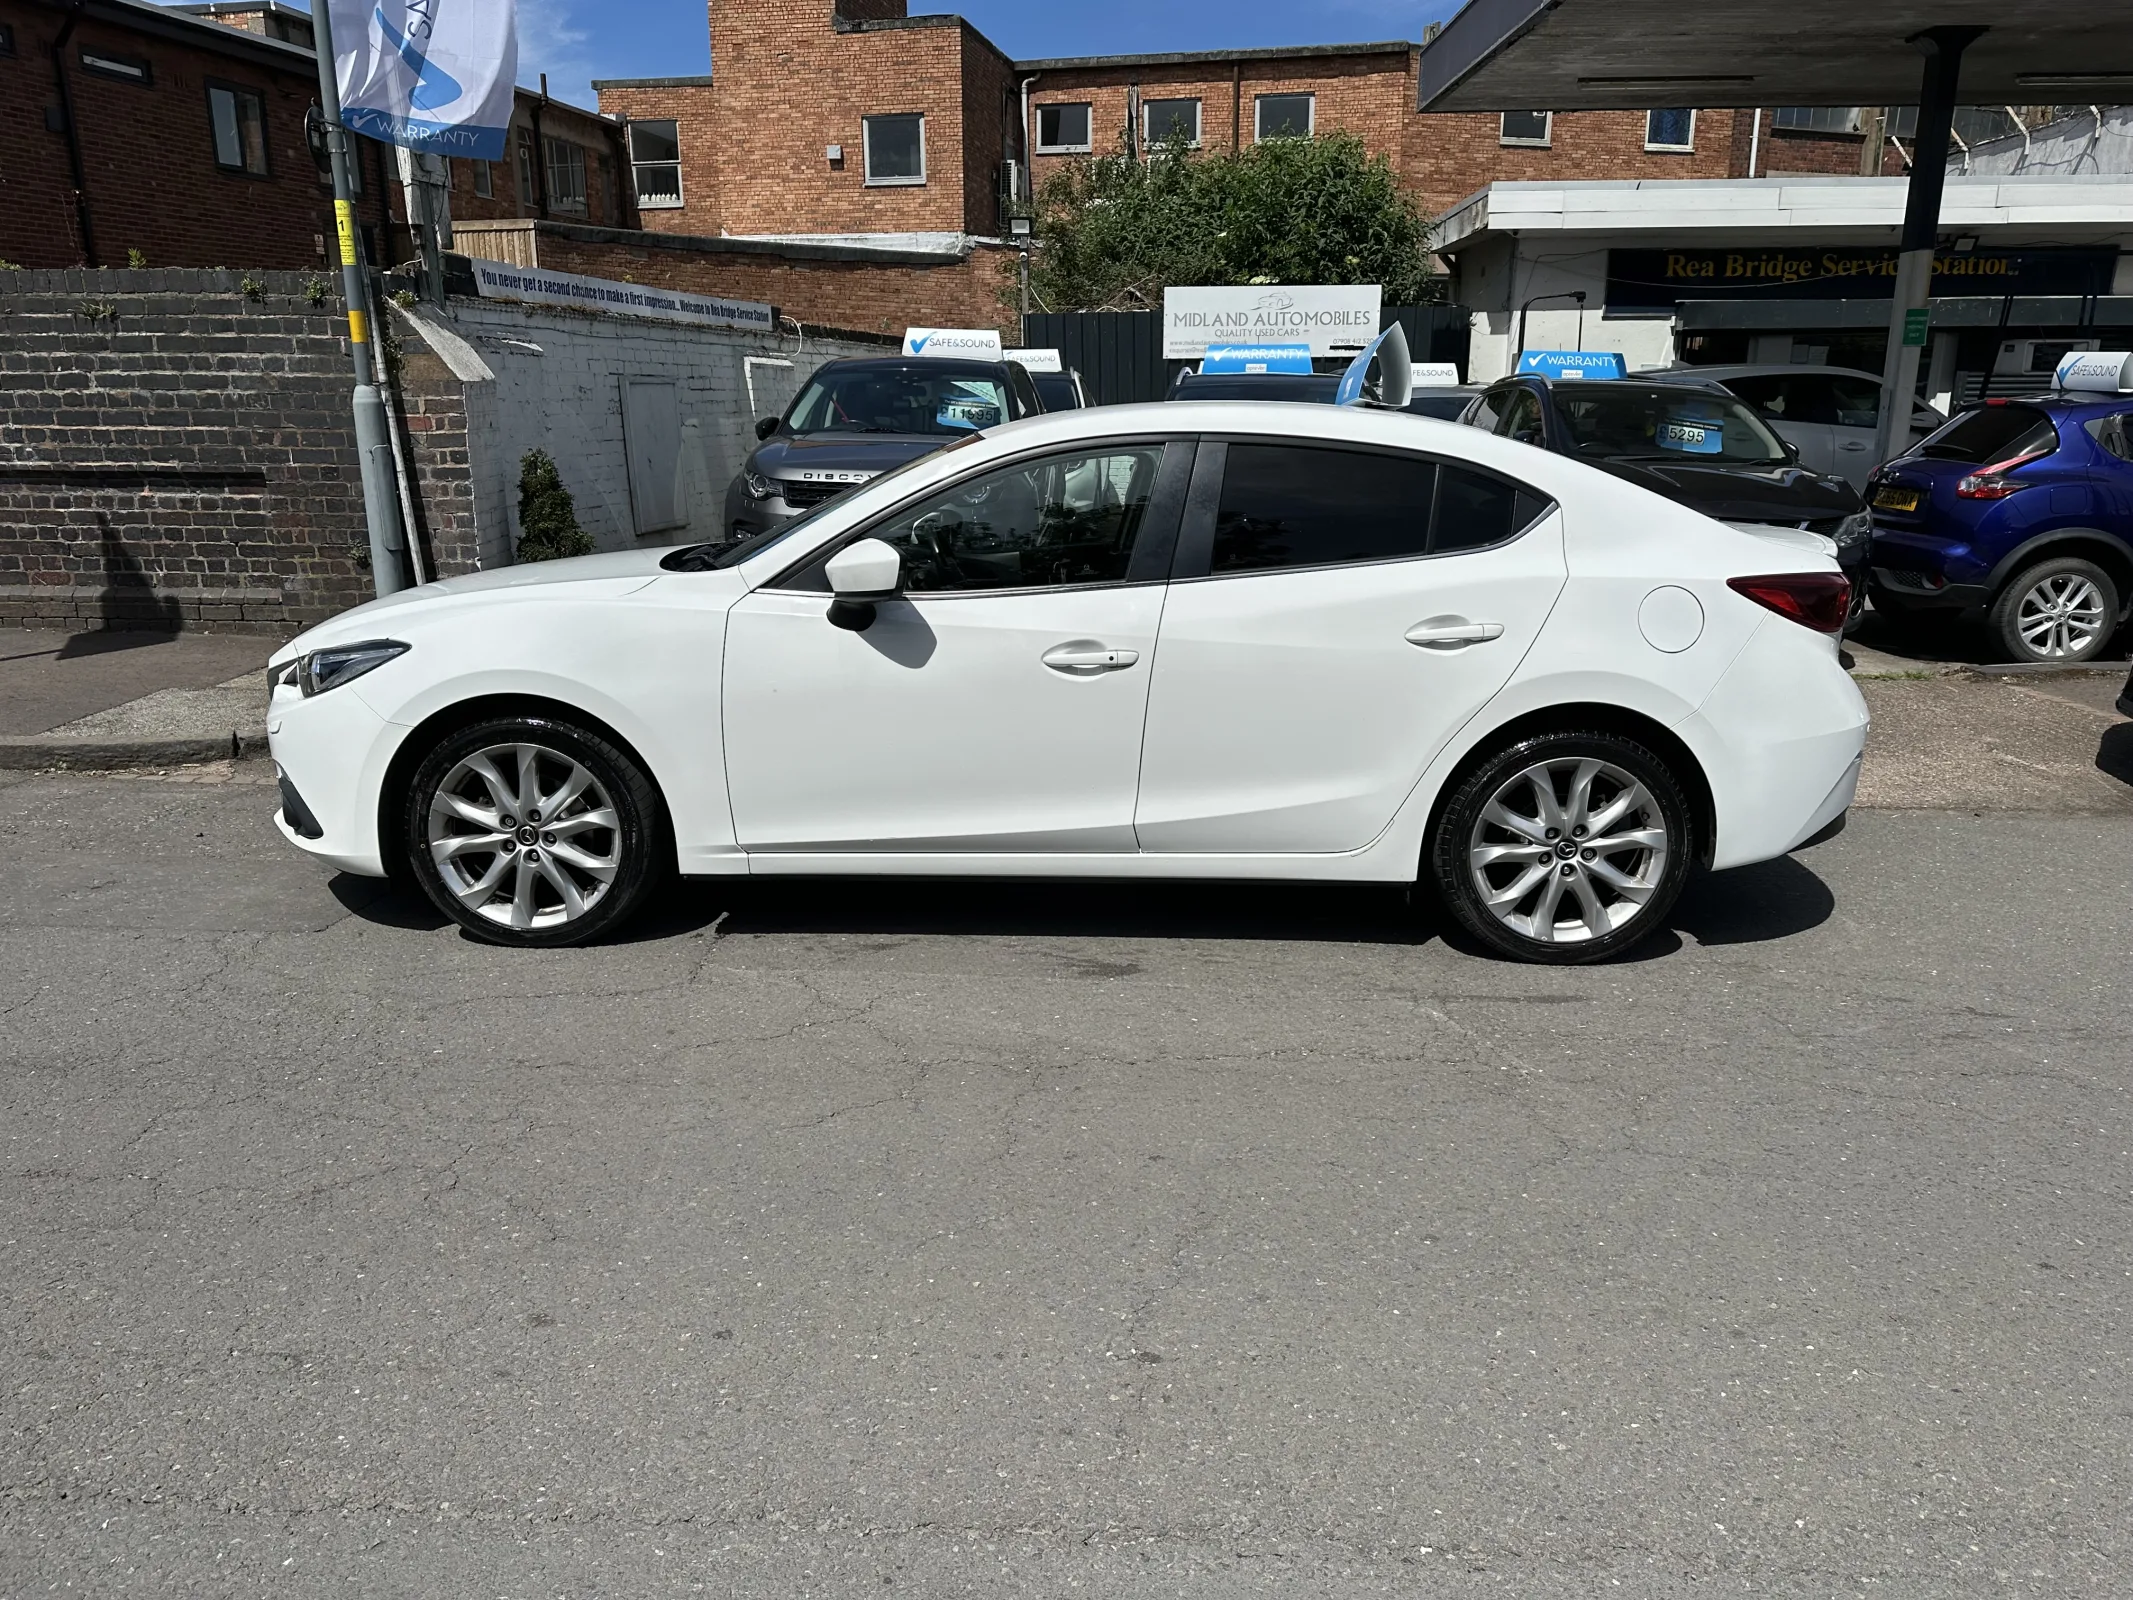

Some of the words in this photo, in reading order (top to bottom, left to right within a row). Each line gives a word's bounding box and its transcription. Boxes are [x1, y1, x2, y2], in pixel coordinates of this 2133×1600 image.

[376, 117, 480, 147] WARRANTY
[338, 219, 345, 232] 1
[1664, 254, 1715, 277] Rea
[1723, 254, 1812, 282] Bridge
[1820, 253, 1899, 276] Servic
[481, 267, 498, 286] You
[498, 273, 522, 290] never
[523, 276, 536, 292] get
[537, 280, 543, 292] a
[543, 279, 571, 297] second
[571, 282, 598, 300] chance
[598, 287, 605, 301] to
[606, 288, 624, 304] make
[624, 293, 630, 305] a
[629, 291, 644, 307] first
[644, 292, 681, 312] impression...
[680, 299, 705, 315] Welcome
[720, 303, 737, 320] Bridge
[736, 306, 754, 322] Service
[753, 309, 769, 323] Station
[1173, 312, 1249, 327] MIDLAND
[1254, 310, 1371, 327] AUTOMOBILES
[1214, 328, 1252, 339] QUALITY
[1255, 328, 1275, 338] USED
[1277, 328, 1300, 337] CARS
[929, 337, 996, 349] SAFE&SOUND
[1006, 355, 1056, 363] SAFE&SOUND
[1231, 347, 1304, 360] WARRANTY
[1546, 355, 1619, 368] WARRANTY
[2070, 364, 2118, 377] SAFE&SOUND
